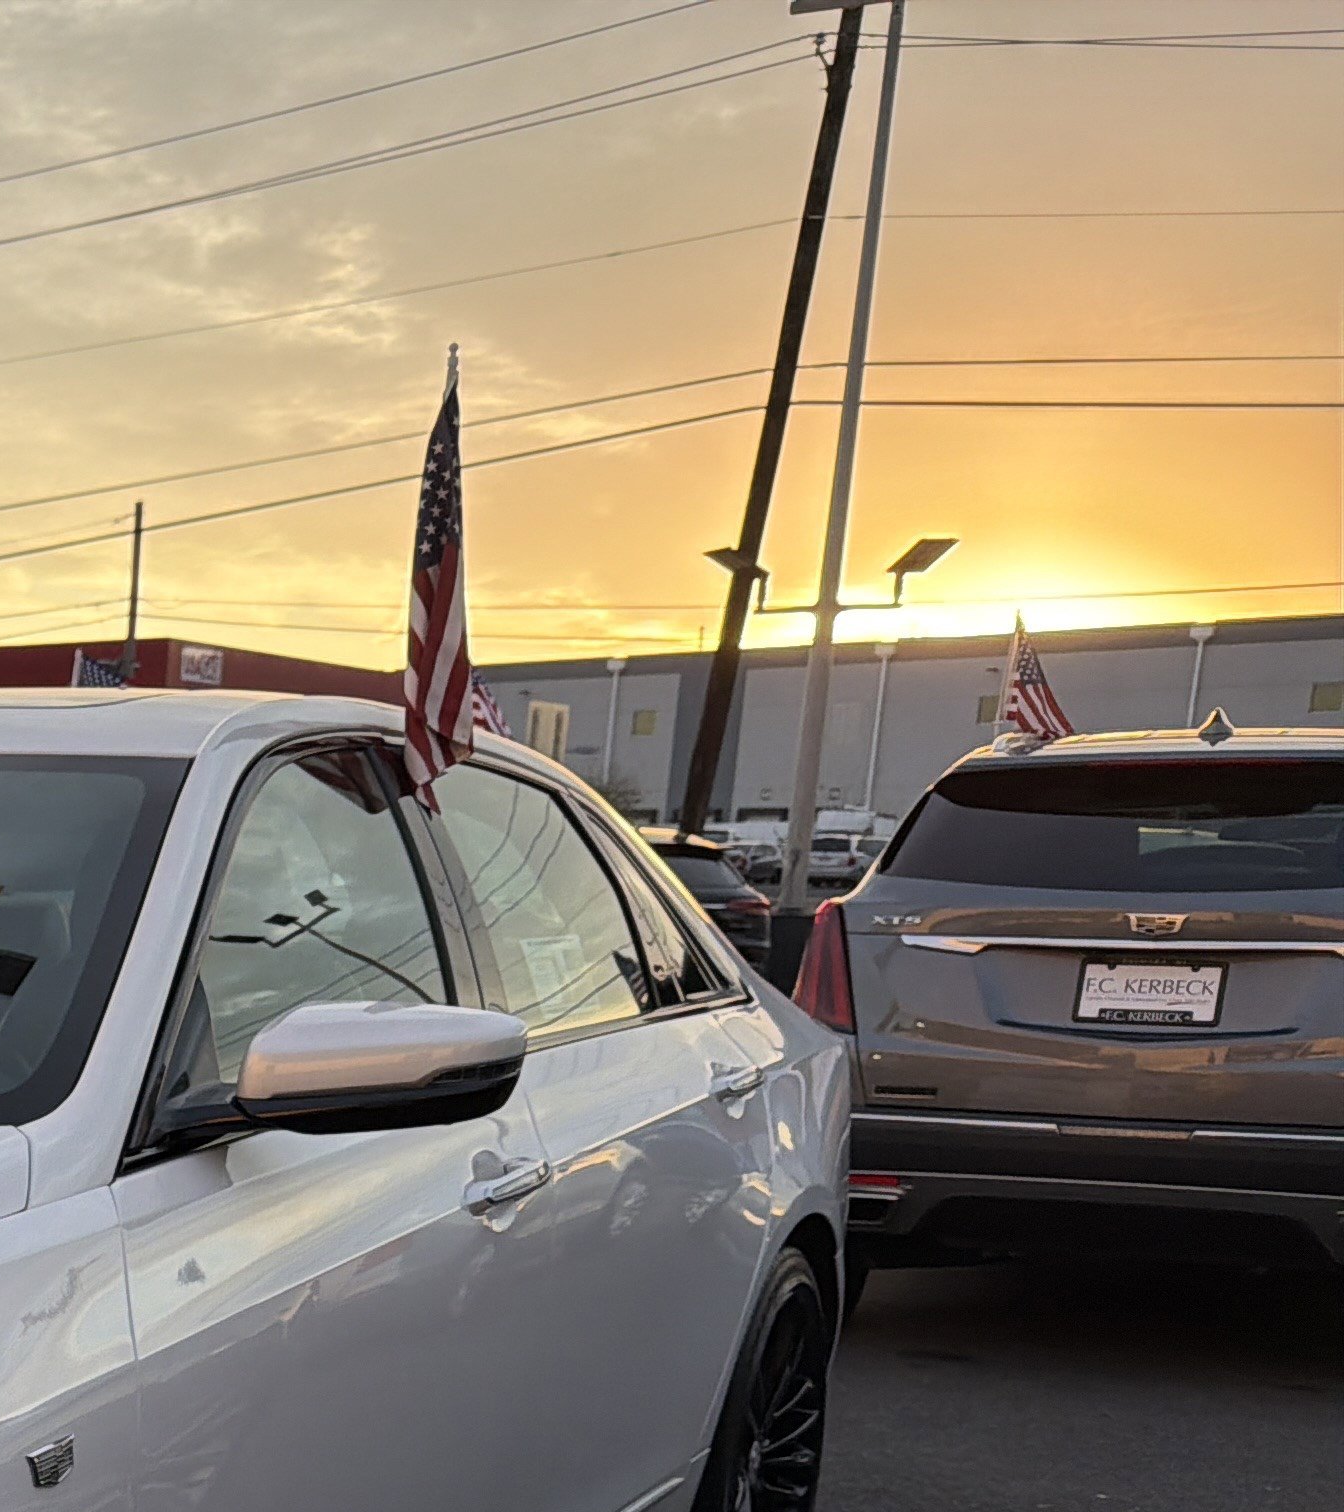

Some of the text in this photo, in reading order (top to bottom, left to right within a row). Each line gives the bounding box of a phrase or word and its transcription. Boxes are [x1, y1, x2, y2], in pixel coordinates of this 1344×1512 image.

[1086, 977, 1215, 996] F.C. KERBECK
[1128, 1011, 1184, 1022] KERBECK
